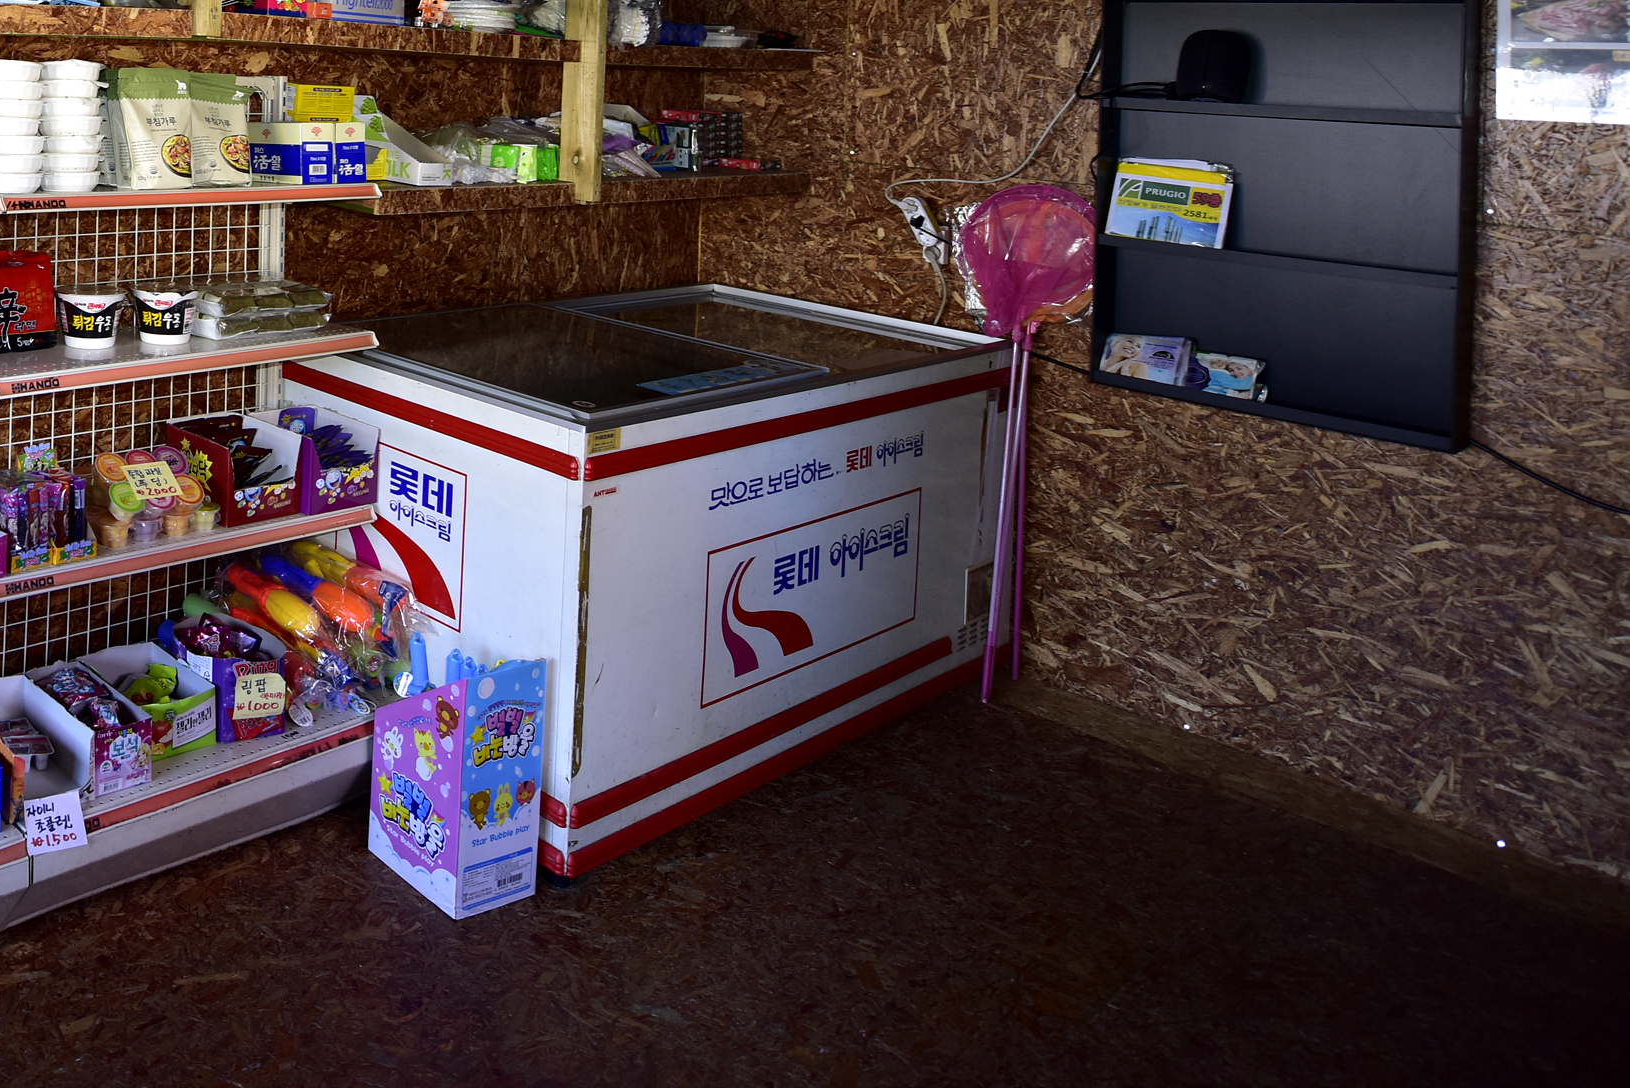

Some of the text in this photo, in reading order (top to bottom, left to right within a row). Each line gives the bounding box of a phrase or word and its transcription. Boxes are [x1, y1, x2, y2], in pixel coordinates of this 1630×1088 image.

[146, 116, 178, 127] 부침가루
[204, 116, 232, 129] 부침가루
[1145, 187, 1187, 200] PRUGIO
[14, 320, 38, 331] 라면
[72, 311, 113, 332] 튀김우동
[142, 311, 181, 328] 튀김우동
[18, 377, 62, 392] HANDO
[709, 477, 765, 511] 맛으로
[845, 448, 873, 473] 롯데
[875, 430, 925, 467] 아이스크림
[389, 460, 454, 518] 롯데
[389, 498, 453, 544] 아이스크림
[772, 514, 911, 597] 롯데 아이스크림
[15, 576, 56, 593] HANDO
[241, 678, 267, 694] 링 팝
[485, 706, 525, 738] 별별
[111, 736, 139, 758] 보석
[391, 771, 432, 819] 별별
[386, 824, 398, 837] Star
[399, 834, 422, 856] Bubble
[471, 822, 531, 848] Star Bubble play
